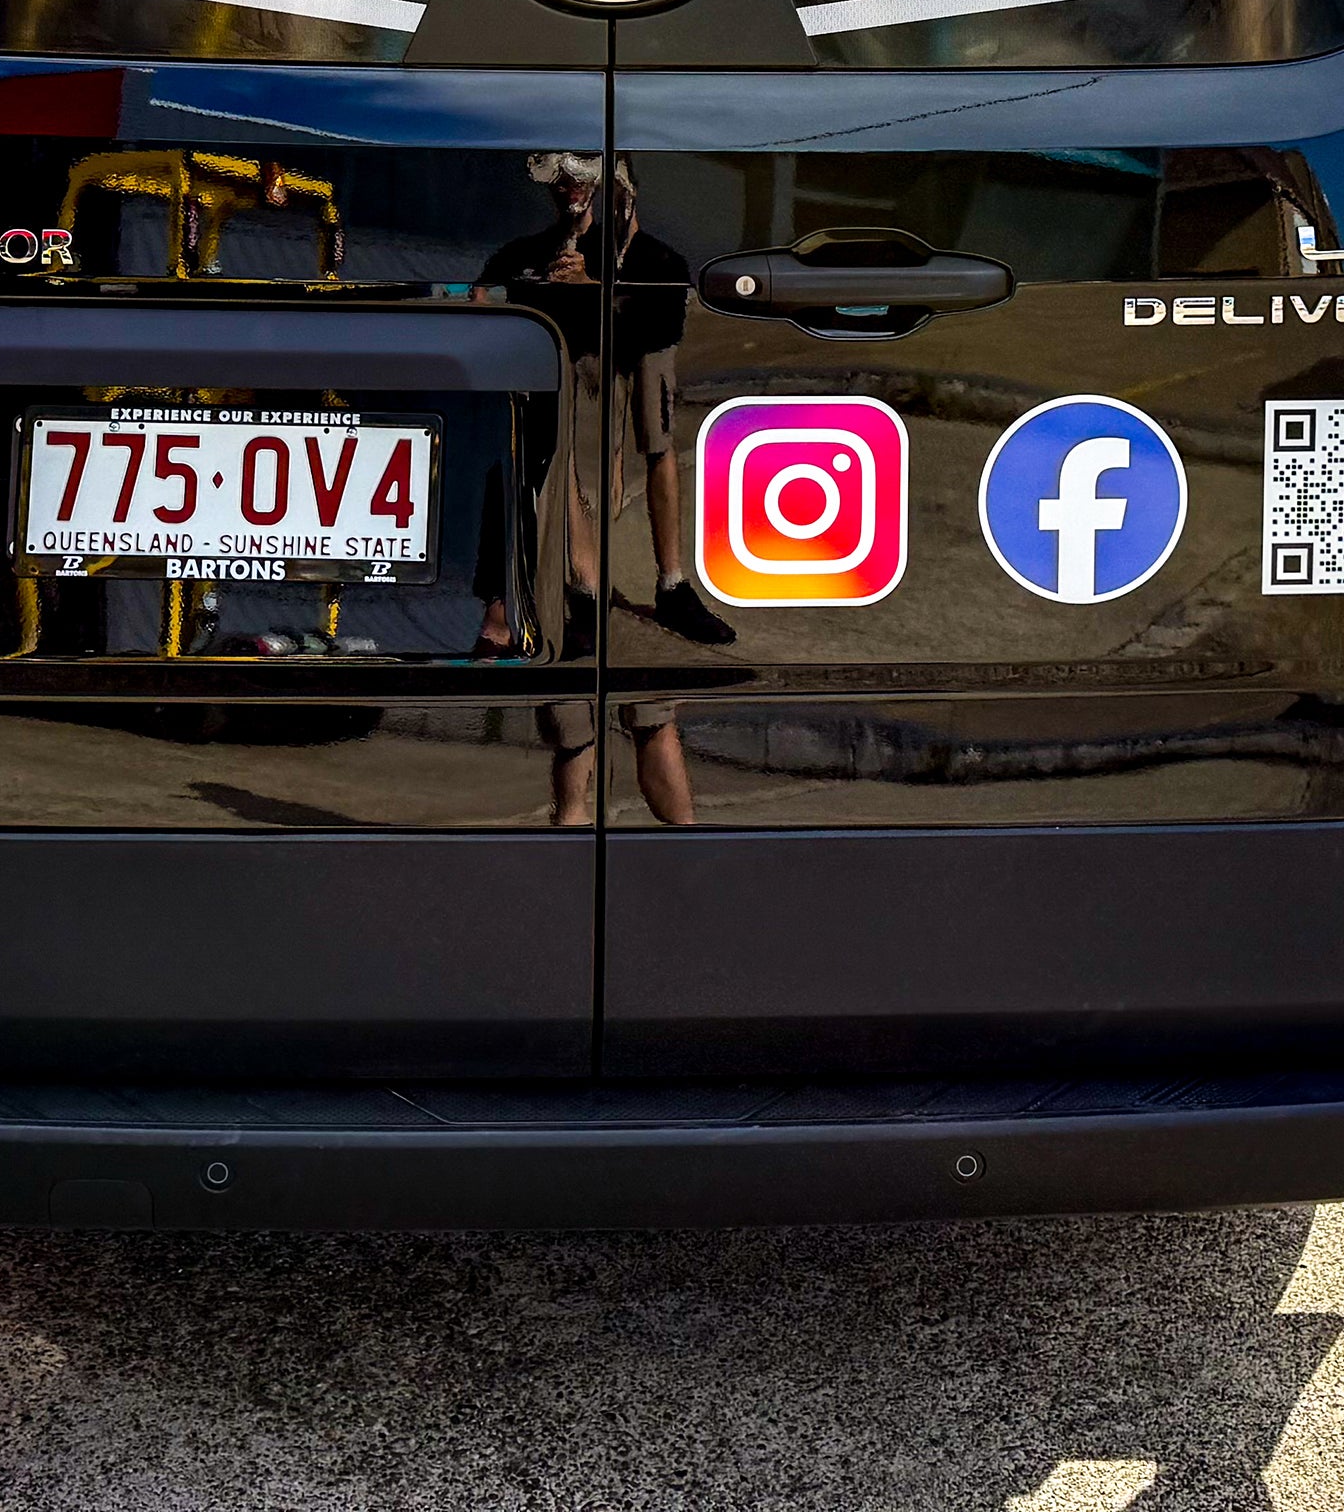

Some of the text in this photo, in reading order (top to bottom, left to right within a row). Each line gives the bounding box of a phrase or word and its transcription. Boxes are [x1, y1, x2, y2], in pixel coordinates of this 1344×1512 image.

[110, 408, 361, 426] EXPERIENCE OUR EXPERIENCE
[42, 531, 193, 554] QUEENSLAND
[219, 534, 331, 556] SUNSHINE
[346, 537, 412, 558] STATE
[167, 558, 286, 581] BARTONS
